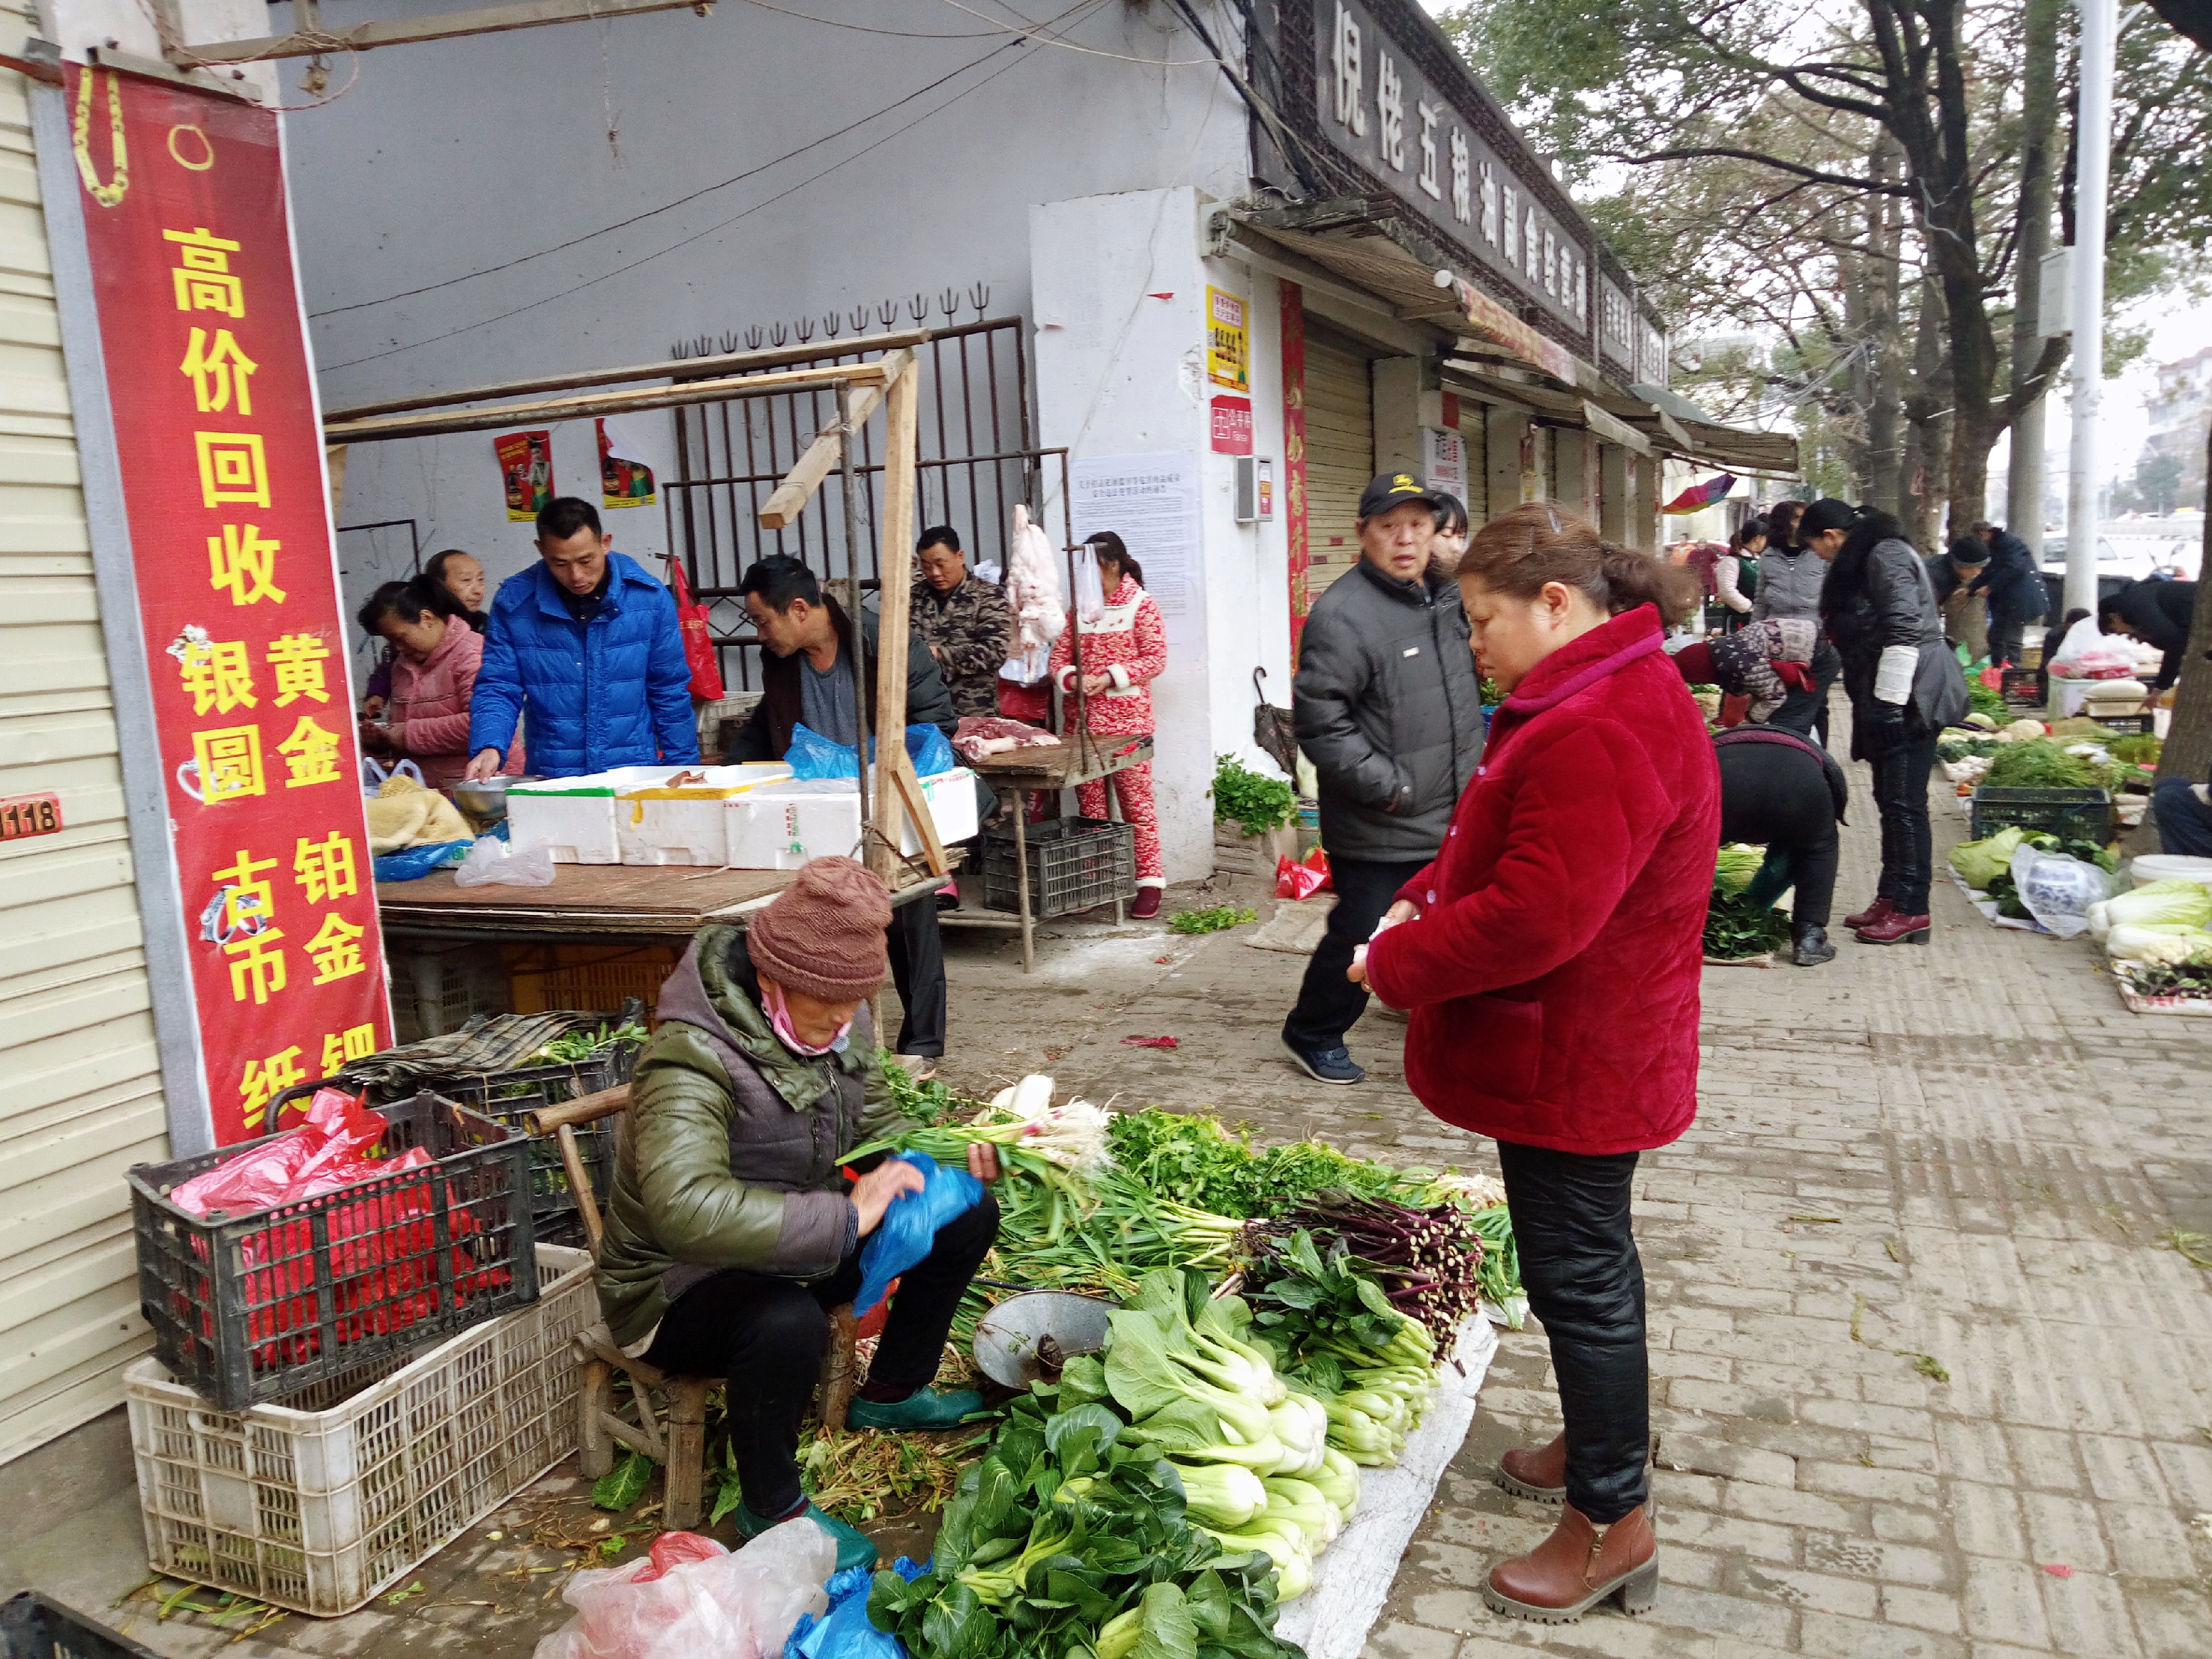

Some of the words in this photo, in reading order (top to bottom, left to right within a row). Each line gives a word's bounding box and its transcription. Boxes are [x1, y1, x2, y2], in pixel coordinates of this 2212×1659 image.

[164, 228, 285, 604] 高价回收
[182, 642, 265, 803] 银圆
[268, 636, 340, 787] 黄金
[213, 851, 285, 1002] 古币
[295, 832, 365, 983] 铂金
